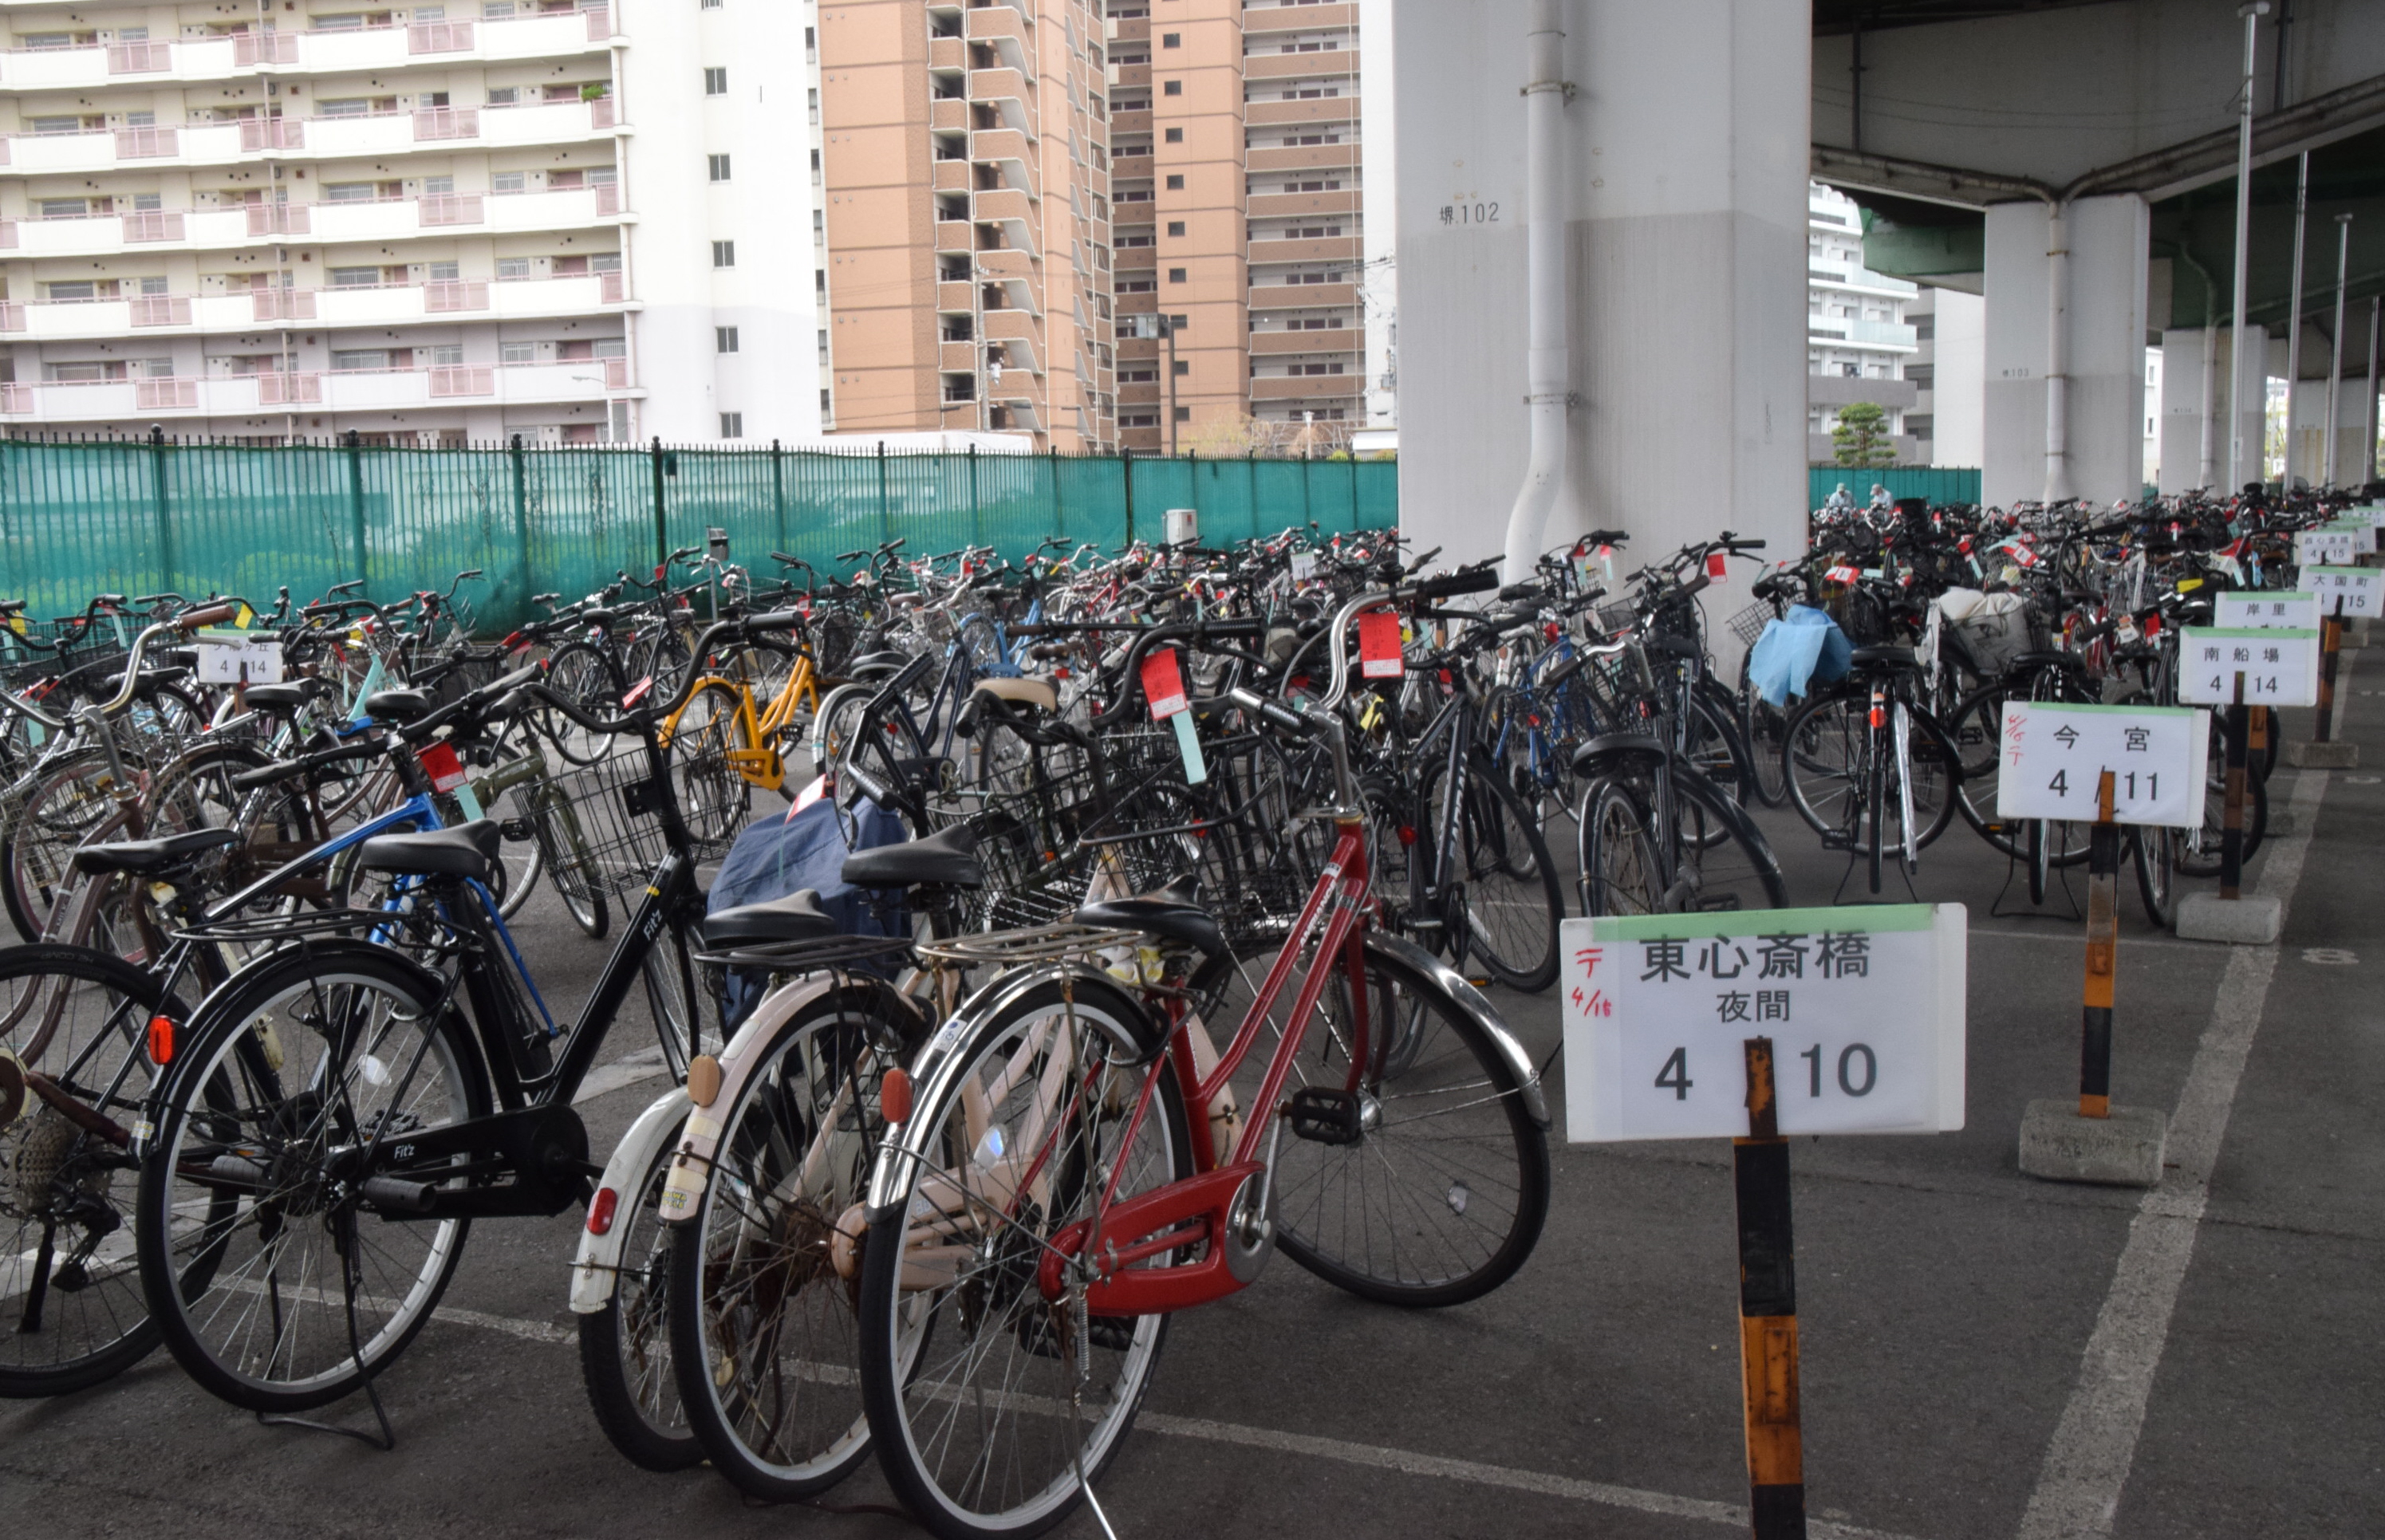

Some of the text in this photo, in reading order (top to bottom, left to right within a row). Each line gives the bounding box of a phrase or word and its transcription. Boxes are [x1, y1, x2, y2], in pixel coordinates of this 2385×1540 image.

[2313, 573, 2369, 588] 大国町
[2246, 602, 2285, 616] 岸里
[2348, 594, 2366, 609] 15
[2204, 646, 2280, 663] 南船場
[220, 660, 266, 673] 4 14
[2210, 675, 2278, 693] 4 14
[2053, 724, 2150, 752] 今宮
[2048, 769, 2068, 798] 4
[2124, 770, 2158, 801] 11
[1638, 929, 1871, 983] 東心斎橋
[1717, 990, 1791, 1022] 夜間
[1654, 1042, 1878, 1101] 4 10
